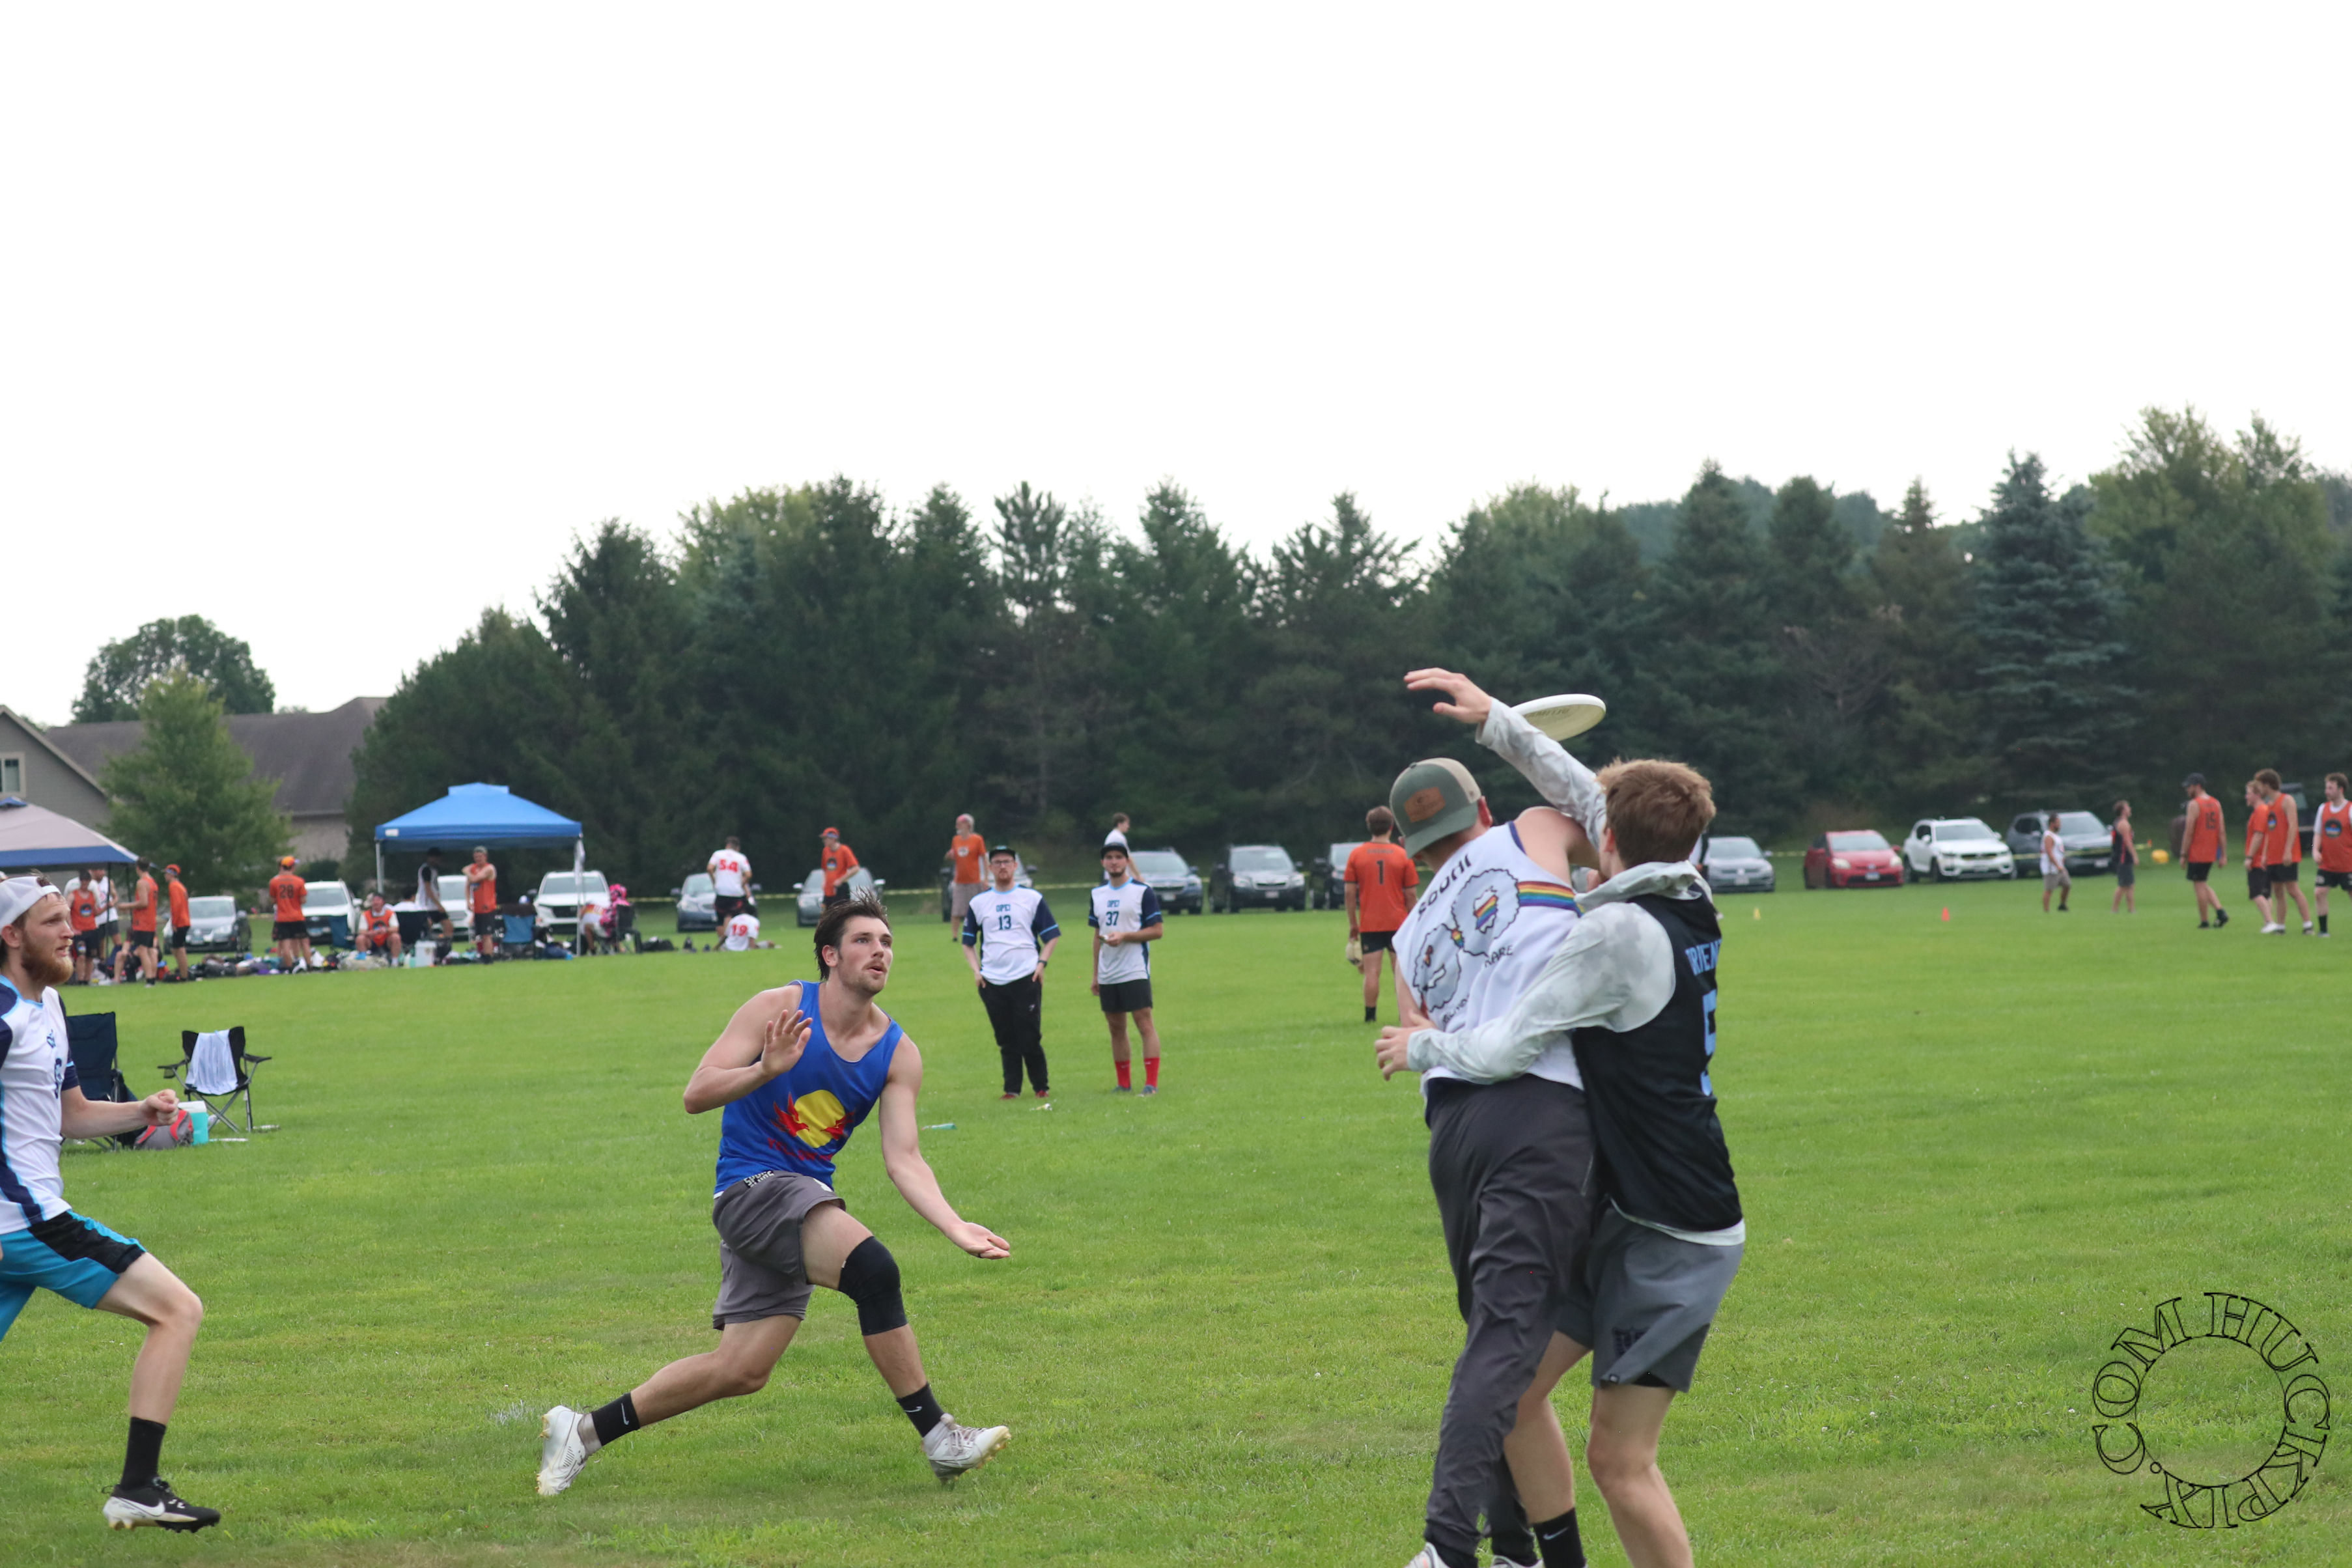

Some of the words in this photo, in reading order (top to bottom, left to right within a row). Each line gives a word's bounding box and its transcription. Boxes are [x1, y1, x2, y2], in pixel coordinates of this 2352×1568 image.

[719, 859, 738, 873] 54
[1376, 860, 1384, 885] 1
[998, 914, 1012, 931] 13
[1105, 911, 1119, 926] 37
[732, 924, 748, 936] 19
